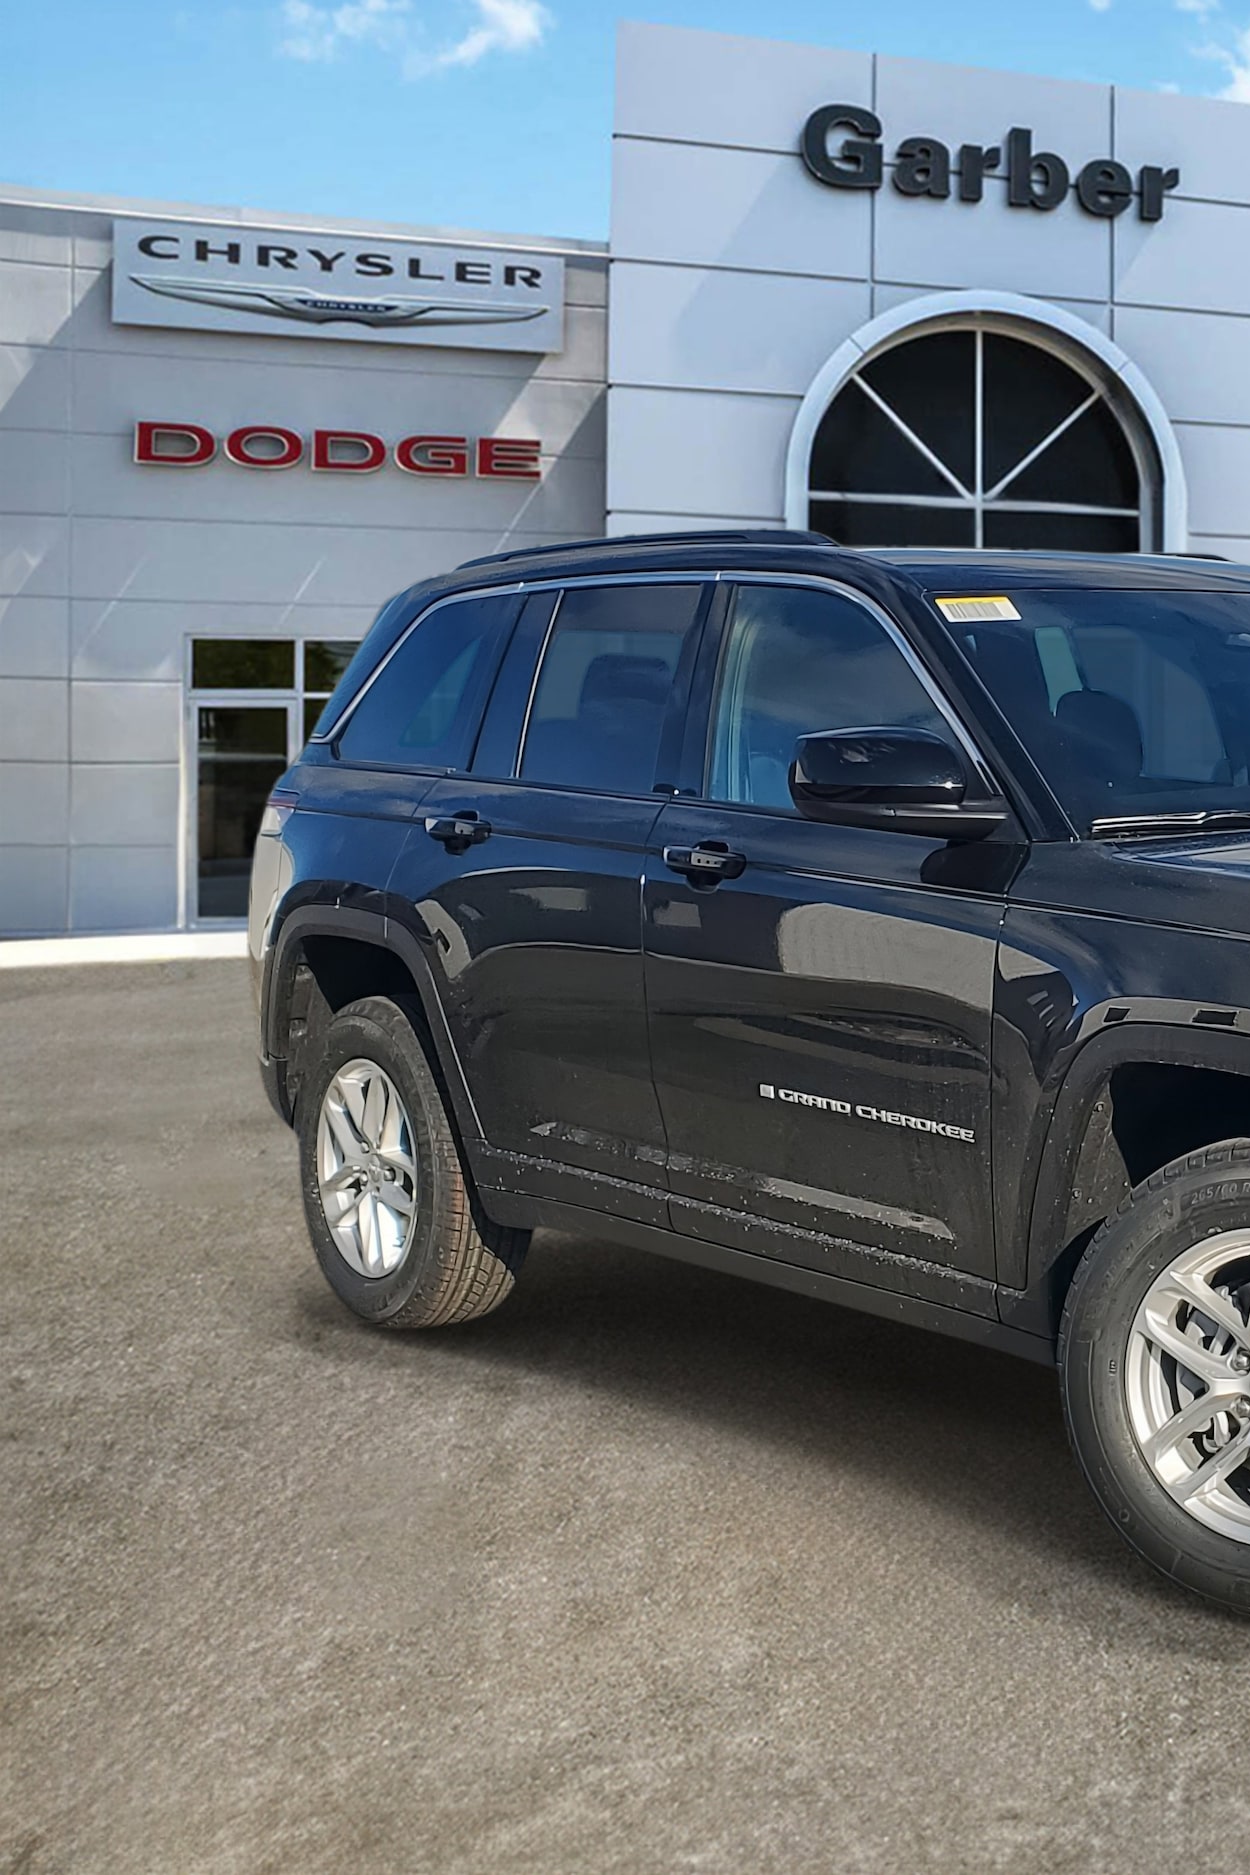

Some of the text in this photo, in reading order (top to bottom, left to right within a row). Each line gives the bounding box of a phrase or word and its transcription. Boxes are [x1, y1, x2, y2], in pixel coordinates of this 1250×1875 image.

[801, 103, 1179, 222] Garber
[138, 235, 542, 288] CHRYSLER
[134, 421, 541, 478] DODGE
[778, 1088, 976, 1143] GRAND CHEROKEE
